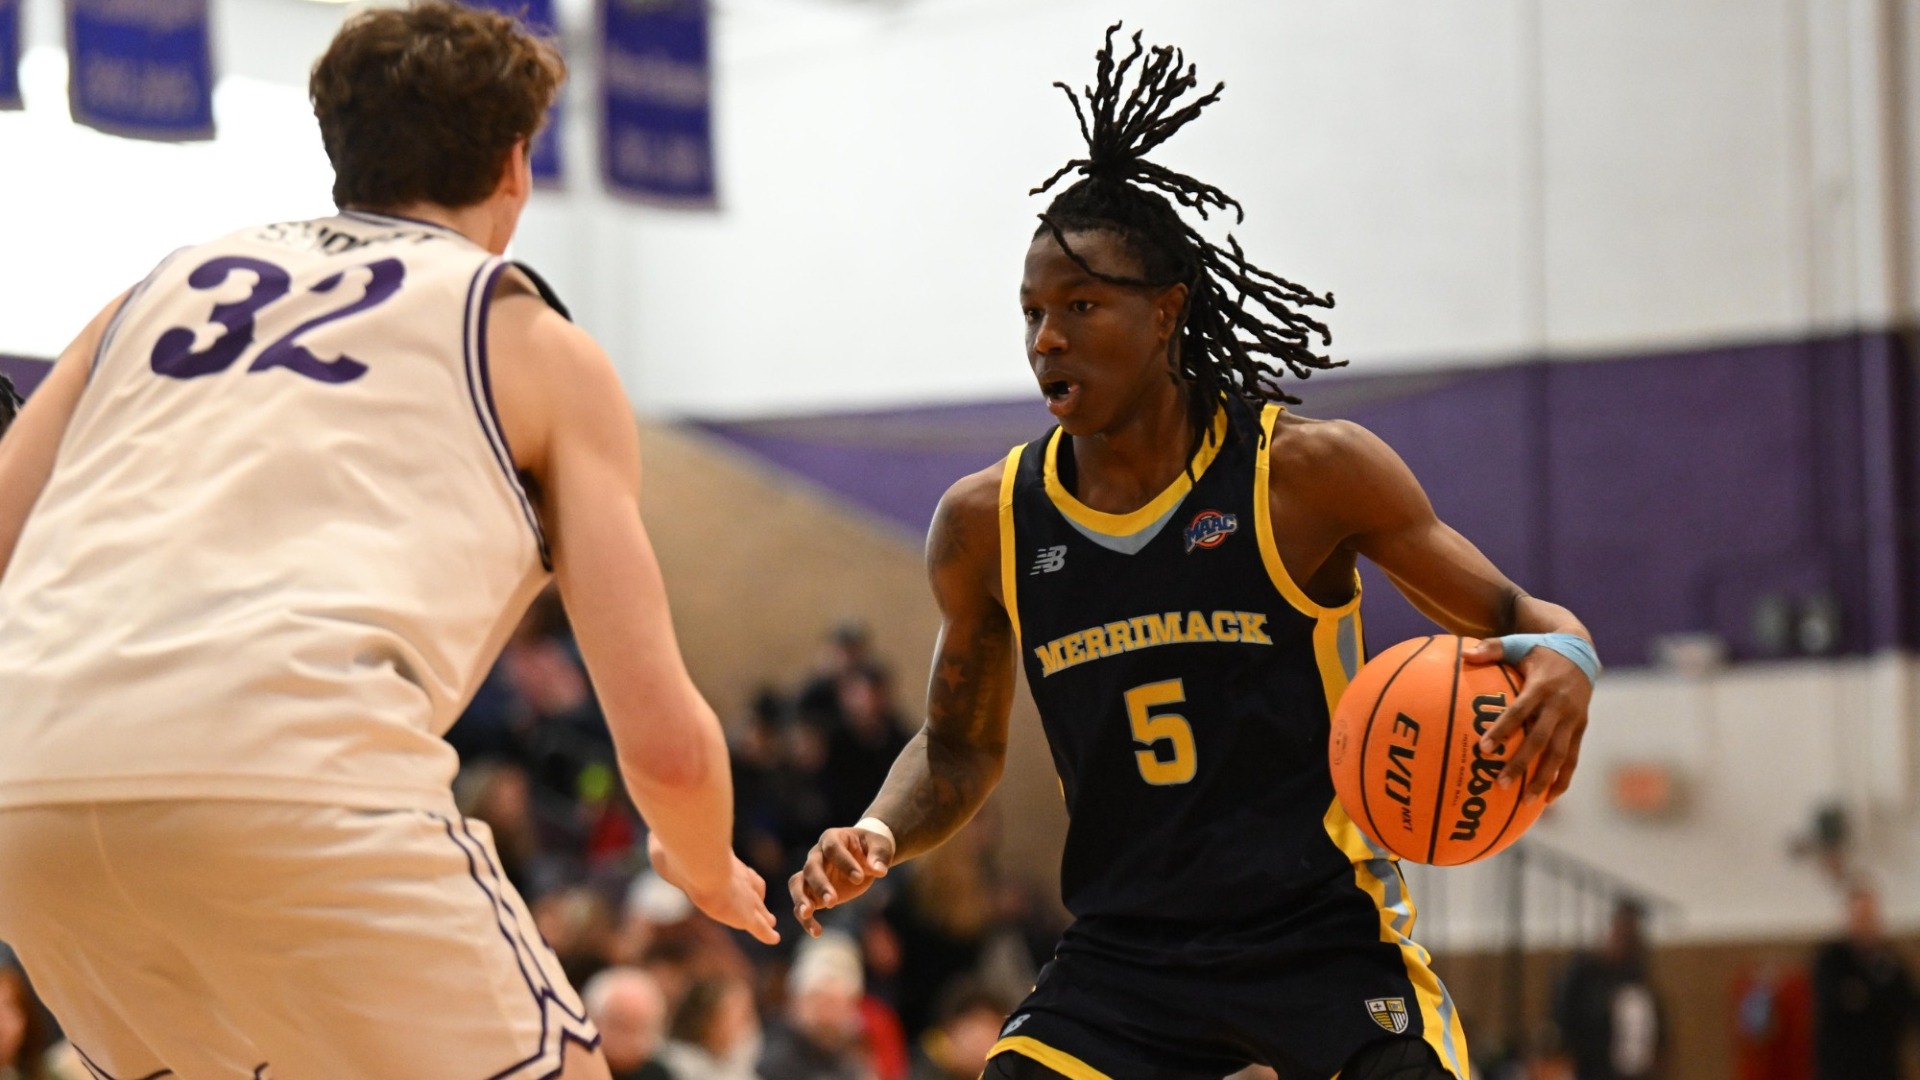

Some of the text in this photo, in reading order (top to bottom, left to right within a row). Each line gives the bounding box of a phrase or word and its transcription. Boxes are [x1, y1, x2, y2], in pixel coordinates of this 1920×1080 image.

[151, 256, 405, 384] 32
[1184, 513, 1237, 553] MAAC
[1034, 611, 1273, 678] MERRIMACK
[1123, 677, 1198, 786] 5
[1385, 711, 1420, 806] EVO
